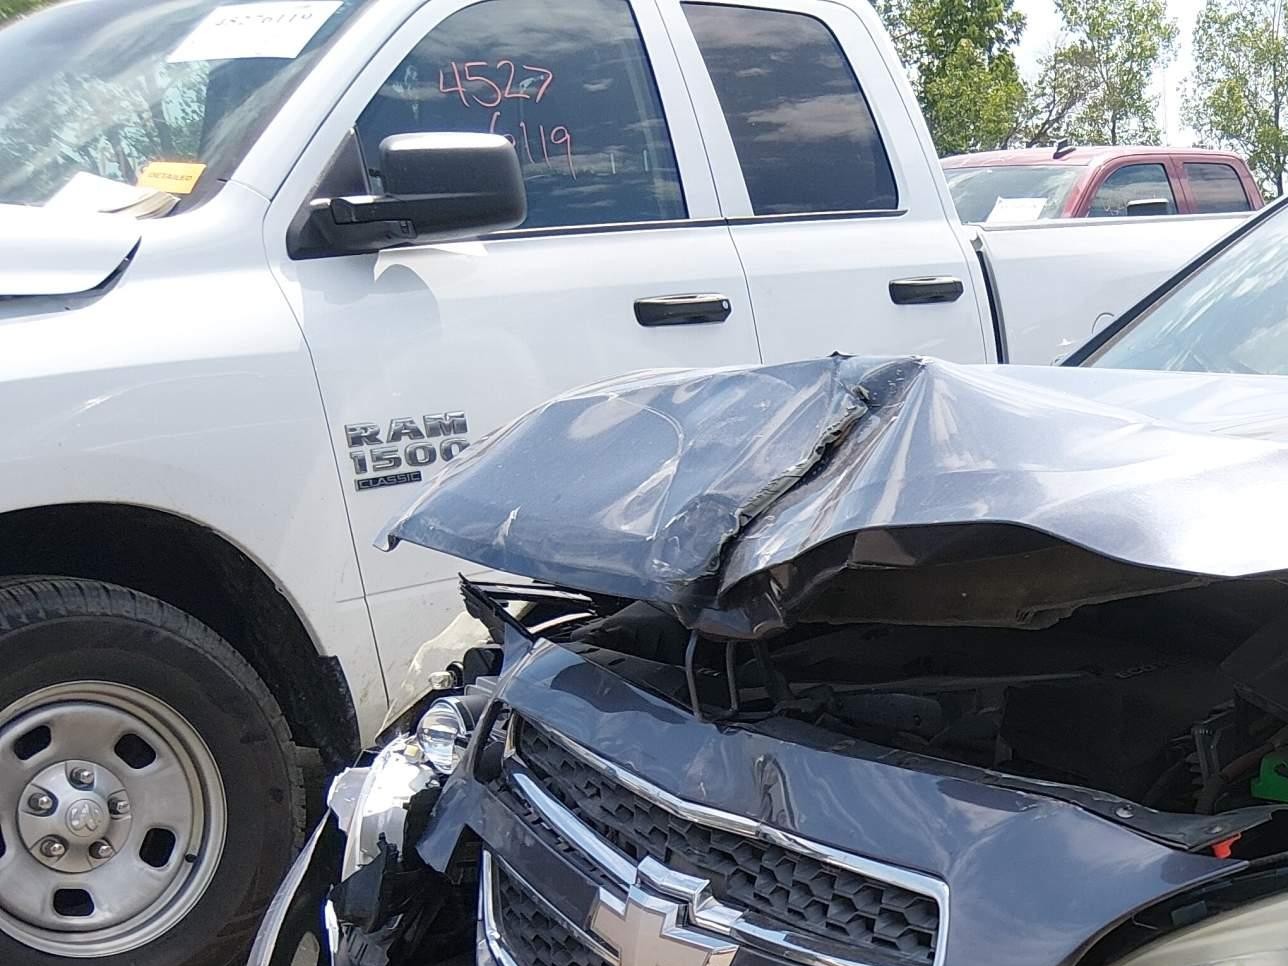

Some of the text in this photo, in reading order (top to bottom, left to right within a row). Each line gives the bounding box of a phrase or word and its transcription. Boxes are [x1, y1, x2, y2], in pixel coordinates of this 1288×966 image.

[439, 60, 553, 107] 4527
[344, 410, 468, 448] RAM
[349, 437, 471, 475] 1500
[356, 471, 422, 491] CLASSIC
